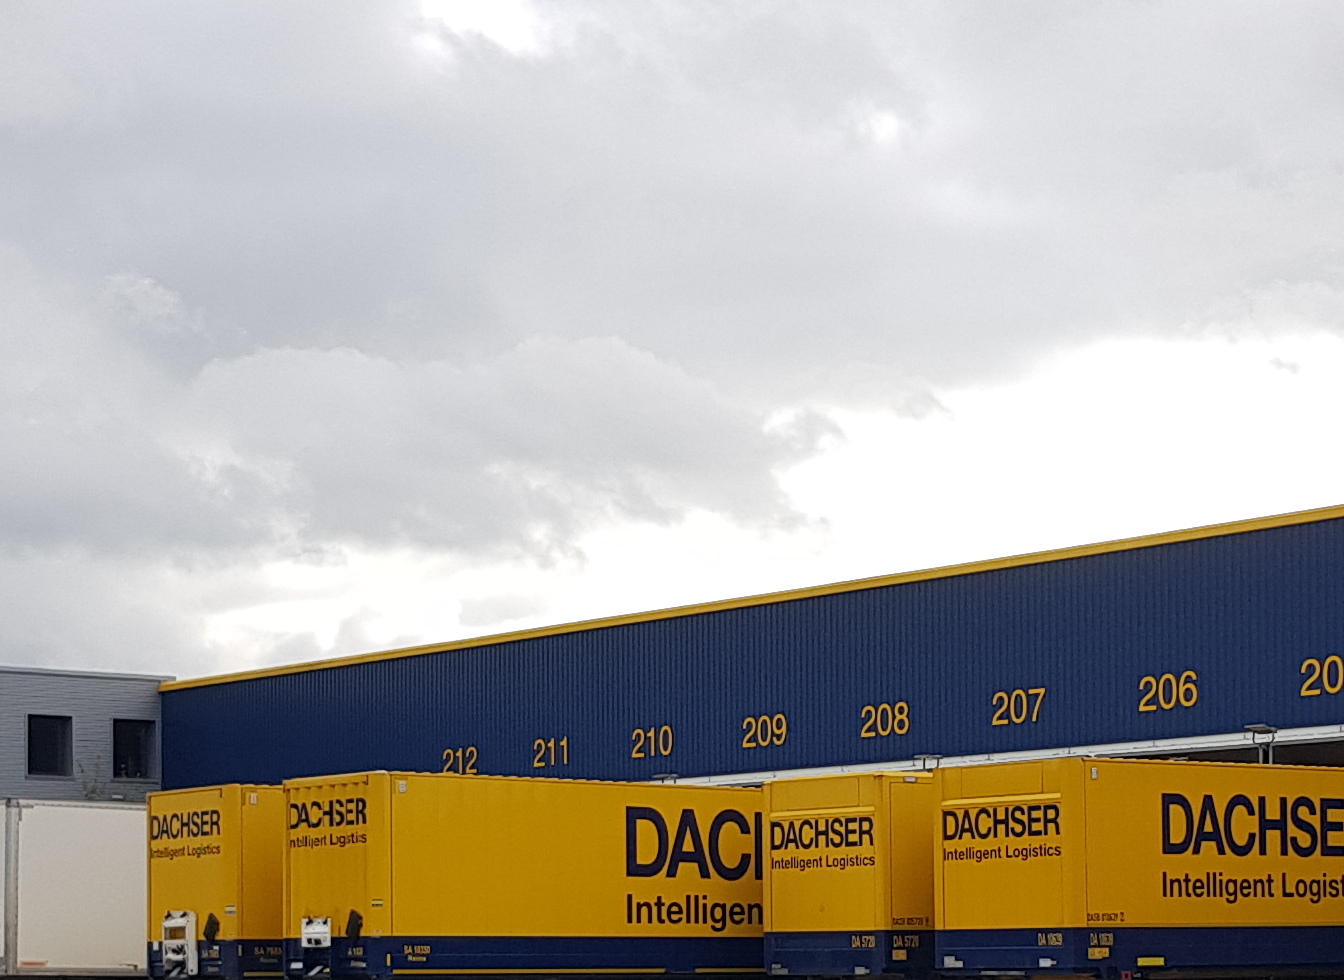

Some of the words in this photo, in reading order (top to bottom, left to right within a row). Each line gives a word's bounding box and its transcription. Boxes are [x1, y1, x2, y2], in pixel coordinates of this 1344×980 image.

[991, 687, 1047, 726] 207
[1138, 670, 1199, 712] 206
[741, 713, 788, 748] 209
[860, 701, 910, 738] 208
[532, 737, 569, 768] 211
[631, 725, 674, 759] 210
[442, 746, 478, 775] 212
[150, 809, 221, 841] DACHSER
[291, 797, 367, 830] DACHSER
[942, 804, 1061, 841] DACHSER
[770, 816, 875, 851] DACHSER
[187, 843, 221, 859] Logistics
[771, 856, 823, 871] Intelligent
[825, 853, 876, 870] Logistics
[943, 846, 1003, 863] Intelligent
[1005, 843, 1062, 861] Logistics
[1162, 871, 1275, 904] Intelligent
